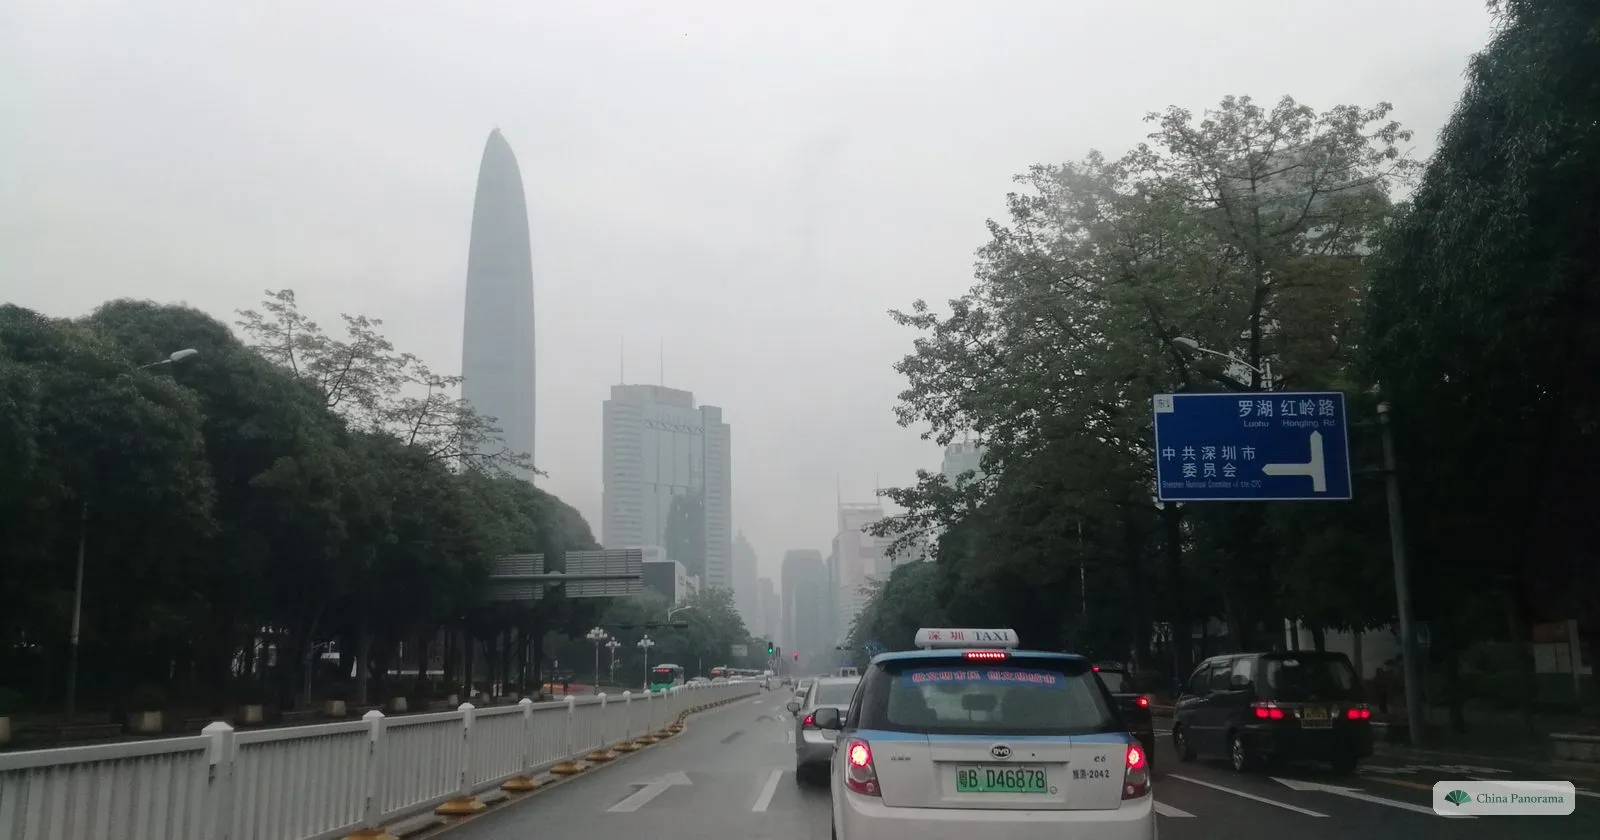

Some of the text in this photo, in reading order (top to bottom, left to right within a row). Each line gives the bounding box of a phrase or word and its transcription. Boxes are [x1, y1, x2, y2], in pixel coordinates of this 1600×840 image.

[1238, 399, 1335, 417] 罗湖 红岭路
[1243, 419, 1335, 428] Luohu Hongling Rd
[1162, 445, 1256, 461] 中共深圳市
[1182, 462, 1237, 478] 委员会
[928, 631, 1009, 641] 深圳 TAXI
[986, 770, 1045, 789] D46878
